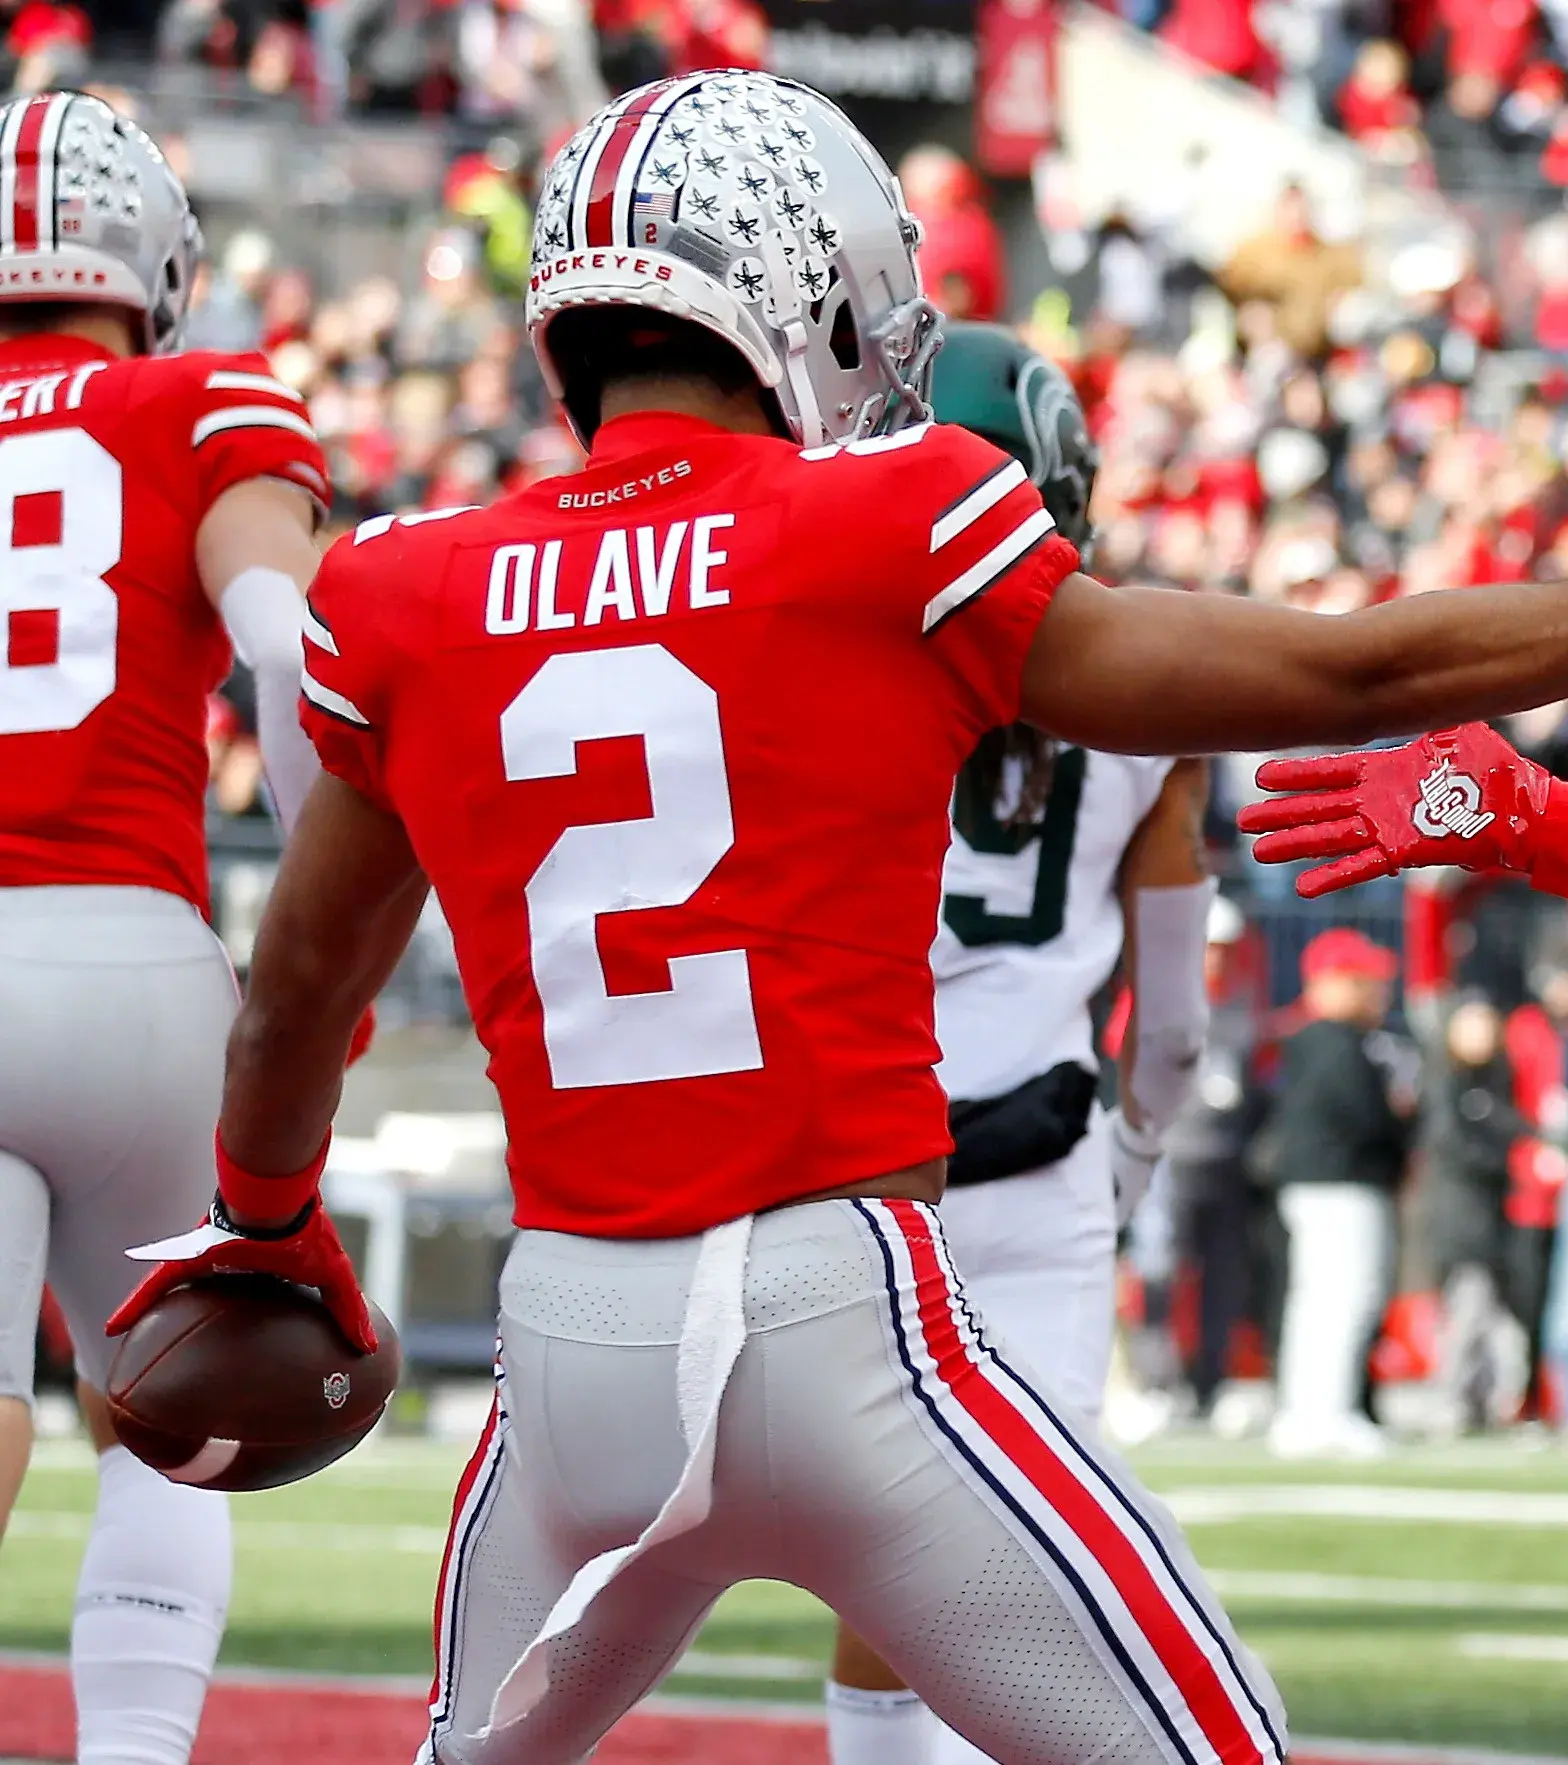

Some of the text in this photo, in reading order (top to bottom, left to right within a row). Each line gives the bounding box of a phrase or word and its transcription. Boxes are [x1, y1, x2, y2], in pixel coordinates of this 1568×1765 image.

[645, 222, 657, 243] 2
[530, 253, 672, 291] BUCKEYES
[558, 460, 692, 508] BUCKEYES
[485, 513, 735, 635] OLAVE
[500, 643, 764, 1089] 2
